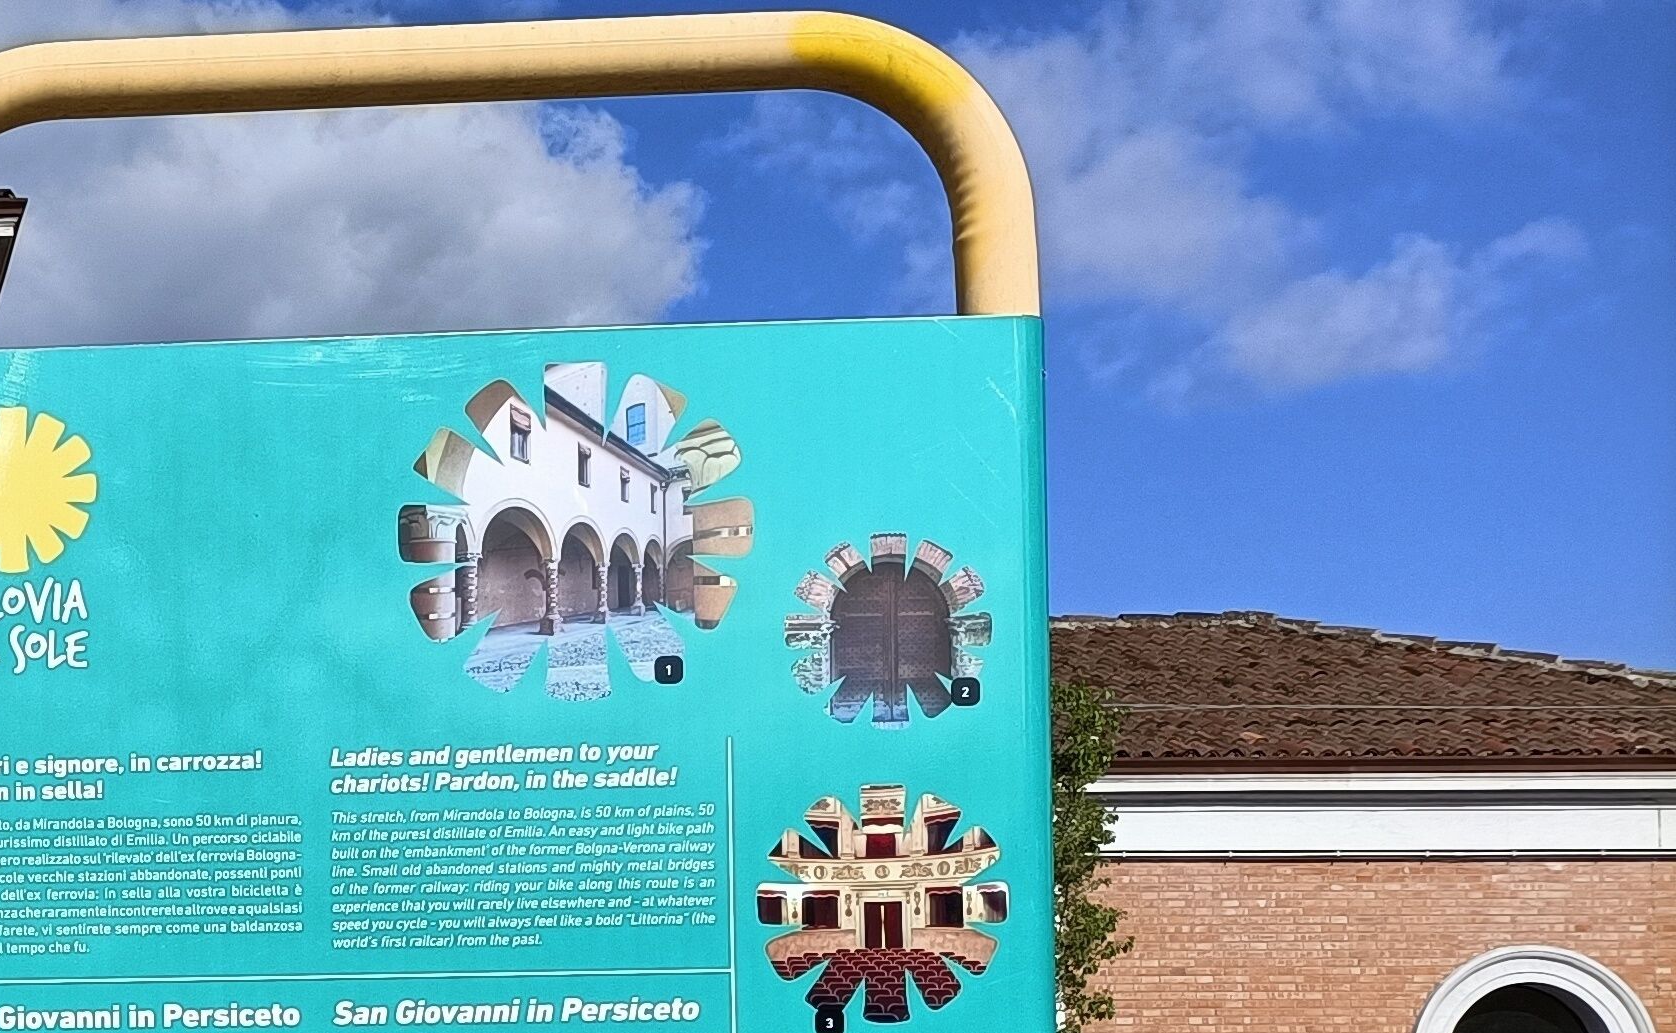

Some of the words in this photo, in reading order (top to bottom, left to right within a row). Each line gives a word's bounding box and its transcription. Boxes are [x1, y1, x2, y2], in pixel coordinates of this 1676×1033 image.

[9, 625, 89, 674] SOLE
[665, 664, 673, 676] 1
[961, 686, 970, 698] 2
[16, 760, 28, 774] e
[35, 755, 124, 777] signore,
[131, 753, 150, 771] in
[157, 750, 261, 771] carrozza!
[331, 747, 403, 766] Ladies
[409, 746, 450, 765] and
[455, 744, 573, 768] gentlemen
[580, 744, 601, 761] to
[606, 745, 659, 764] your
[16, 782, 35, 800] in
[42, 780, 102, 799] sella!
[331, 773, 429, 793] chariots!
[434, 771, 520, 791] Pardon,
[525, 770, 546, 788] in
[553, 769, 588, 788] the
[593, 767, 677, 787] saddle!
[15, 819, 30, 830] da
[33, 817, 95, 830] Mirandola
[97, 820, 104, 828] a
[163, 818, 193, 827] sono
[196, 815, 211, 826] 50
[214, 815, 233, 826] km
[236, 814, 247, 825] di
[361, 864, 398, 876] Small
[402, 864, 421, 875] old
[426, 862, 494, 877] abandoned
[498, 861, 547, 874] stations
[552, 860, 576, 872] and
[580, 860, 623, 874] mighty
[627, 859, 663, 871] metal
[667, 858, 715, 872] bridges
[129, 1005, 154, 1027] in
[164, 1003, 300, 1027] Persiceto
[333, 1001, 387, 1025] San
[396, 999, 520, 1024] Giovanni
[527, 999, 553, 1022] in
[561, 997, 699, 1021] Persiceto
[825, 1017, 834, 1029] 3
